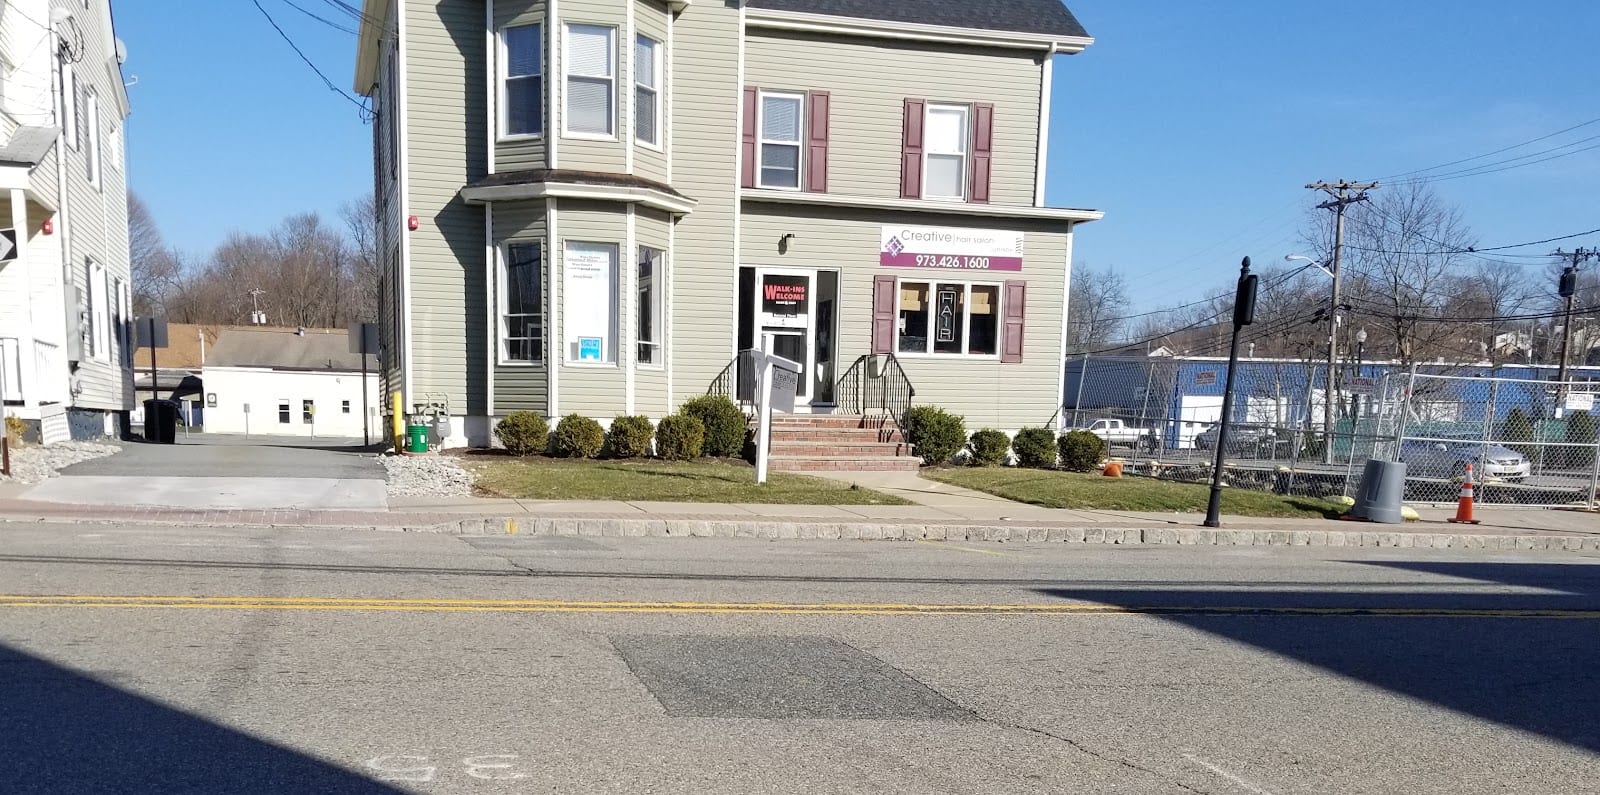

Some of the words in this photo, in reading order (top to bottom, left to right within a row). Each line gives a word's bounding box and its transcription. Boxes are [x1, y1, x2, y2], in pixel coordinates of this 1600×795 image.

[901, 229, 952, 243] Creative
[956, 235, 971, 244] hair
[973, 237, 995, 245] salon
[916, 254, 990, 269] 973.426.1600
[765, 290, 805, 301] WELCOME
[940, 293, 953, 340] HAIR
[773, 369, 797, 385] Creative
